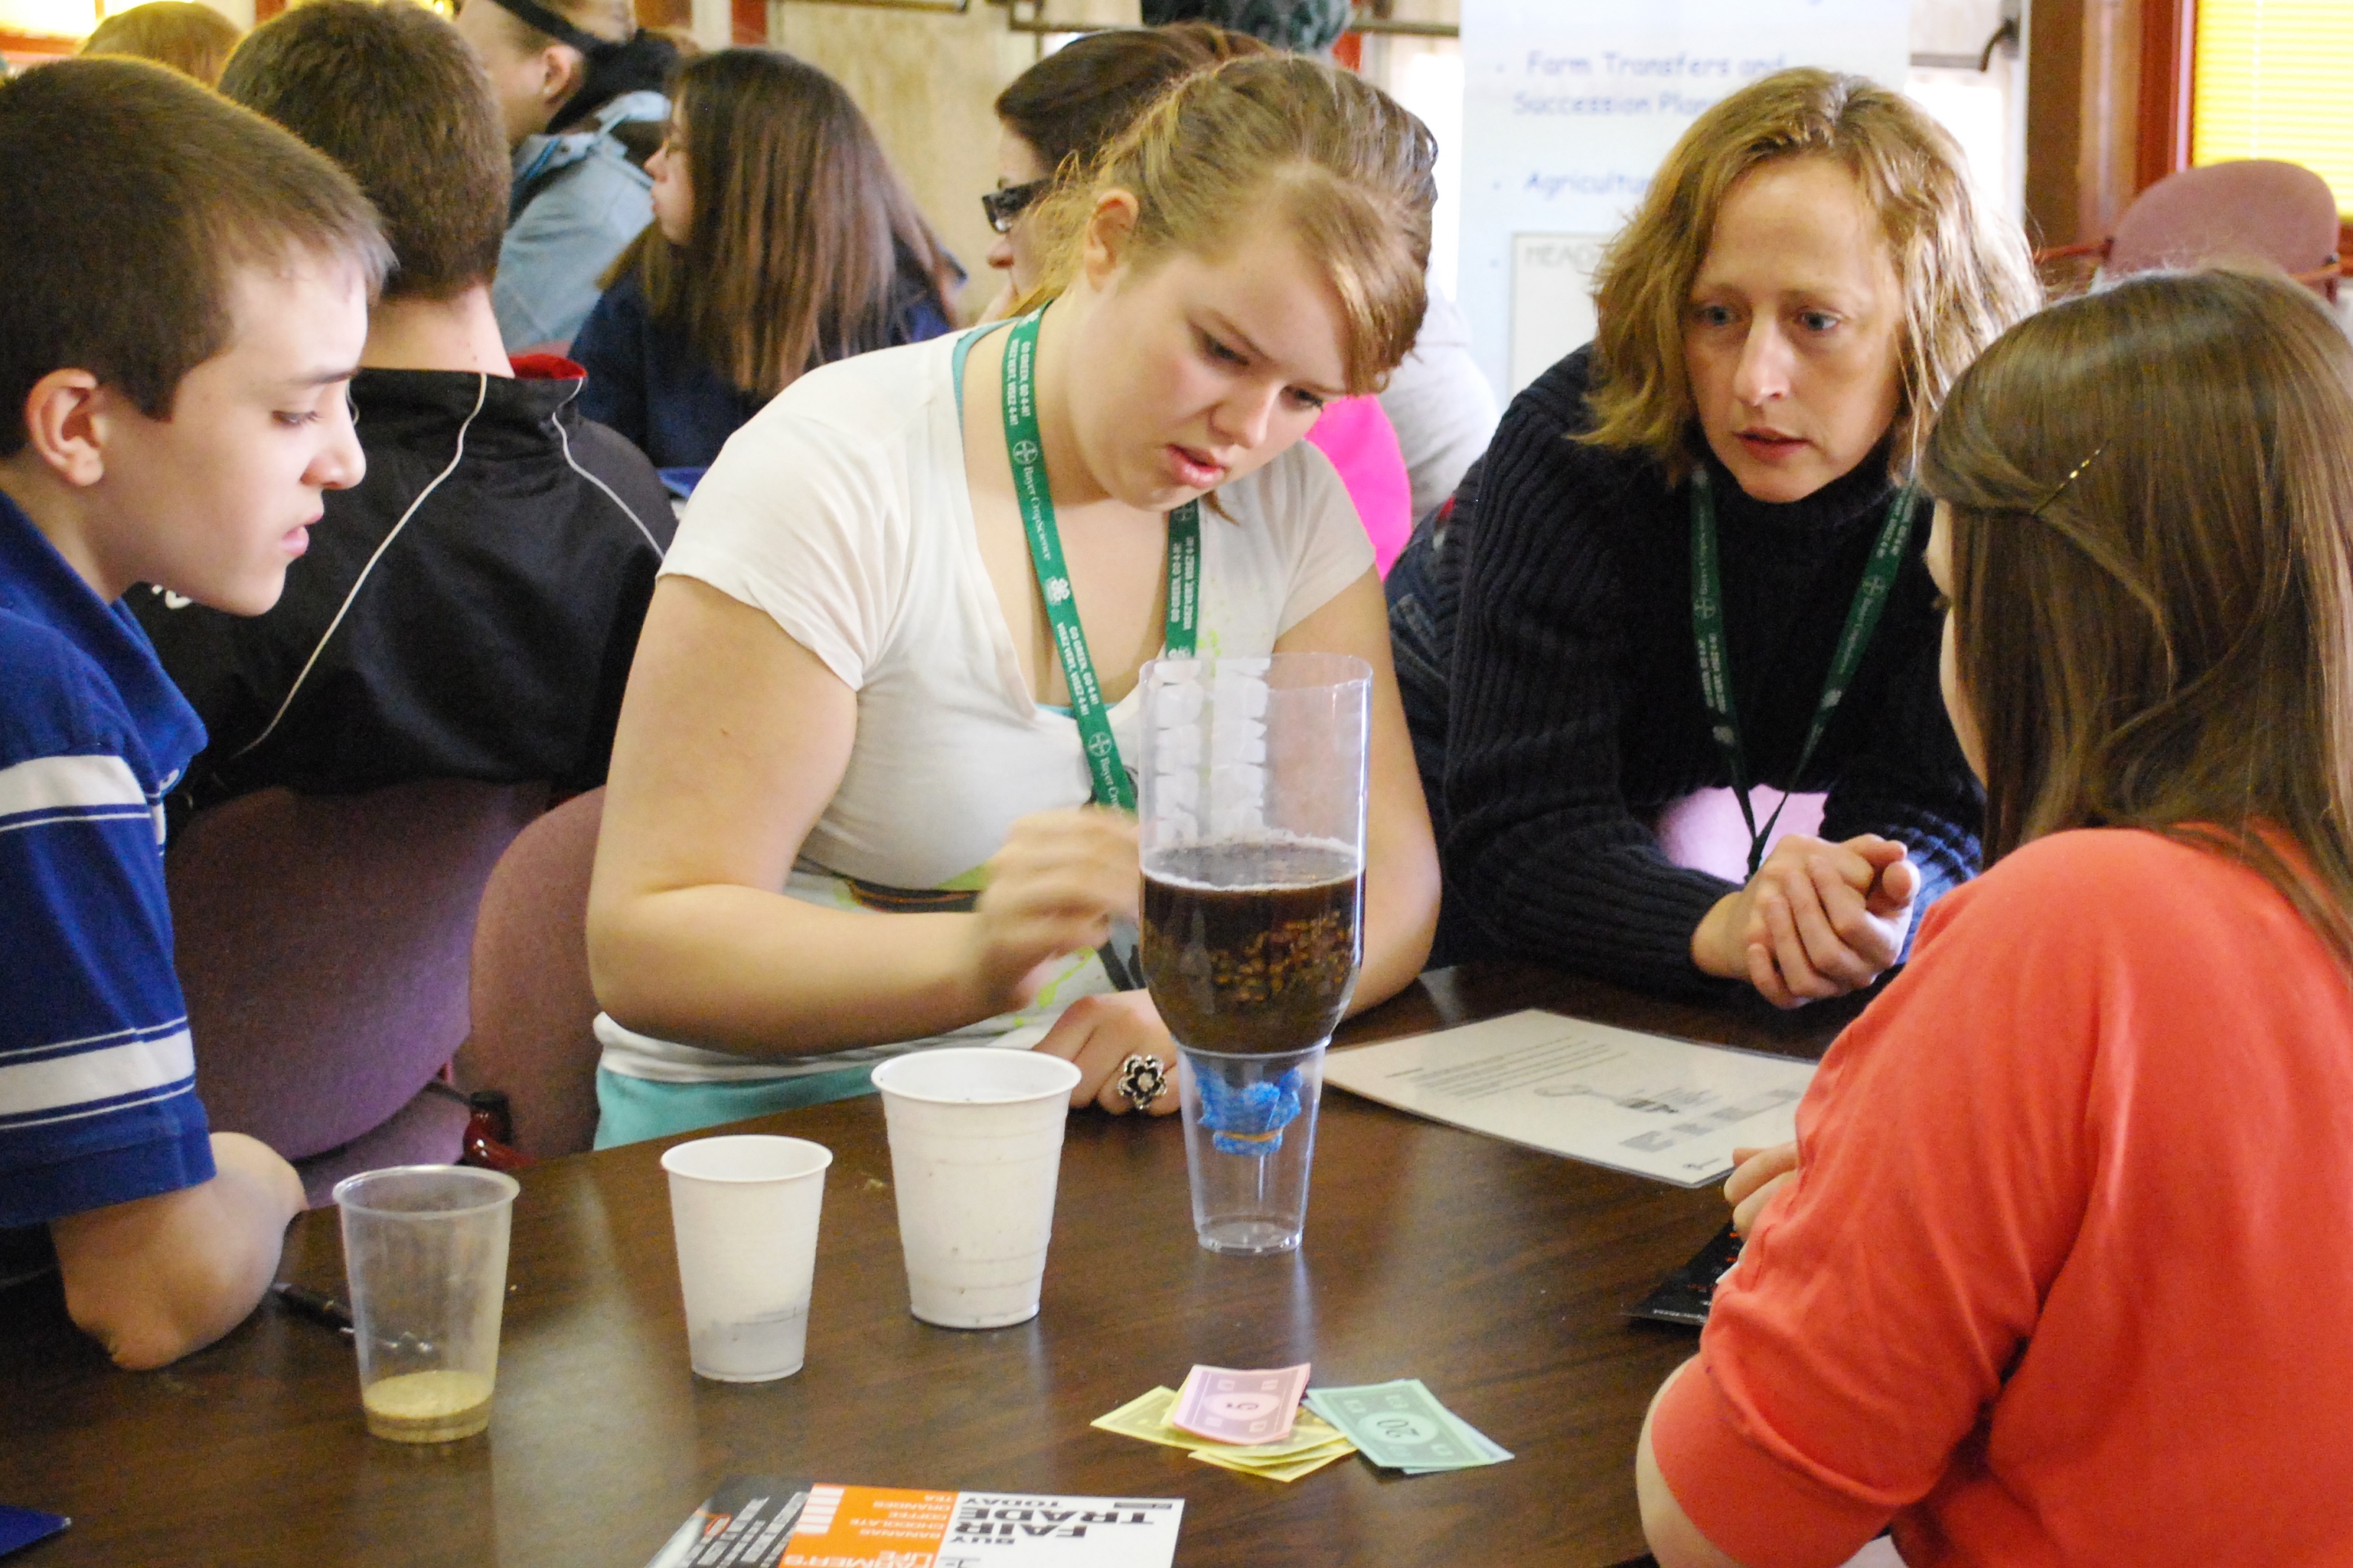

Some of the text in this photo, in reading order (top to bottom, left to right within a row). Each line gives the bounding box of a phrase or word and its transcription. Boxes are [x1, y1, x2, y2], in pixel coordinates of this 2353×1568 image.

[1527, 50, 1592, 76] Farm
[1602, 50, 1730, 76] Transfers
[1513, 90, 1650, 115] Succession
[1023, 466, 1051, 560] Bayer CropScience
[1069, 626, 1079, 640] GO
[1083, 672, 1093, 685] GO
[1100, 756, 1114, 786] Bayer
[1226, 1402, 1259, 1411] 5
[1376, 1420, 1420, 1438] 20
[924, 1494, 951, 1502] TEA
[962, 1498, 1061, 1508] TODAY
[873, 1501, 951, 1511] ORANGES
[888, 1512, 947, 1520] COFFEE
[958, 1507, 1154, 1524] TRADE
[849, 1518, 944, 1530] CHOCOLATE
[955, 1521, 1087, 1538] FAIR
[860, 1529, 941, 1539] BANANAS
[952, 1535, 1015, 1545] BUY
